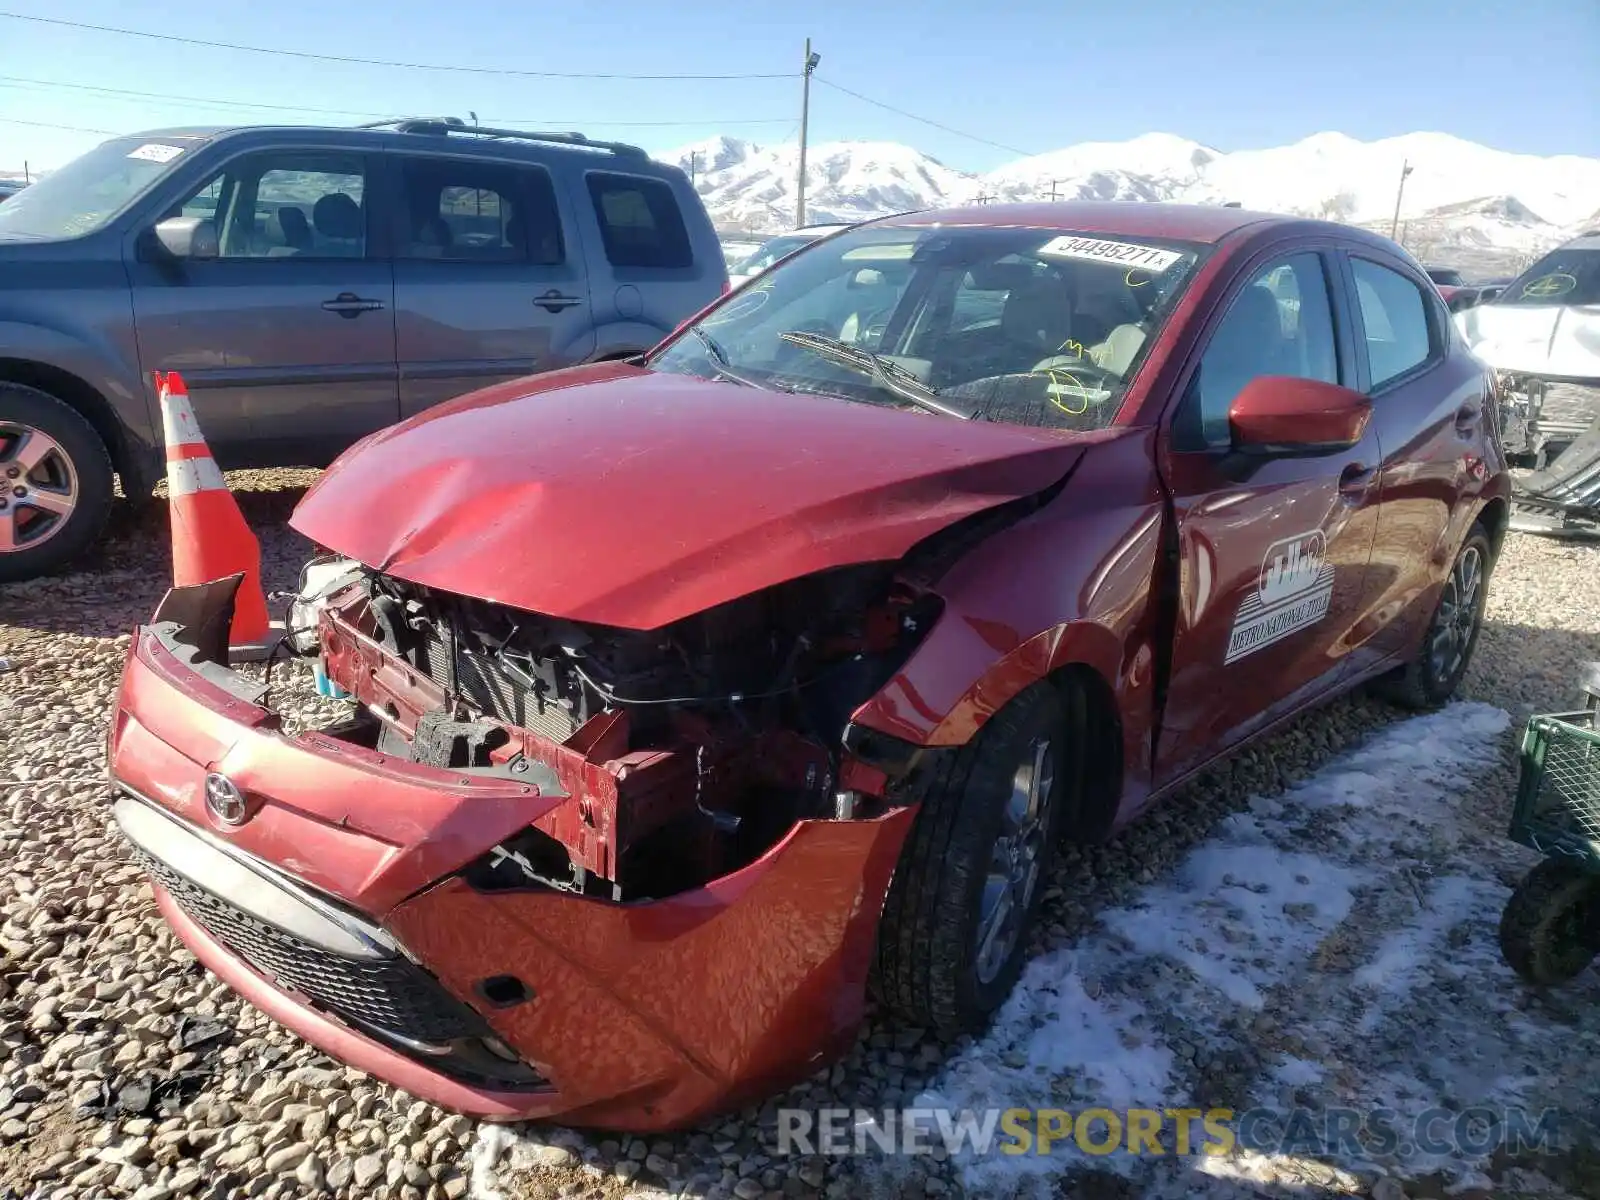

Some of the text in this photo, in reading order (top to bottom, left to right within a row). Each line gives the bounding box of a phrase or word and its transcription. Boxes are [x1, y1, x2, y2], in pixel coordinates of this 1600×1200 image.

[1230, 592, 1330, 652] METRO NATIONAL TITLE
